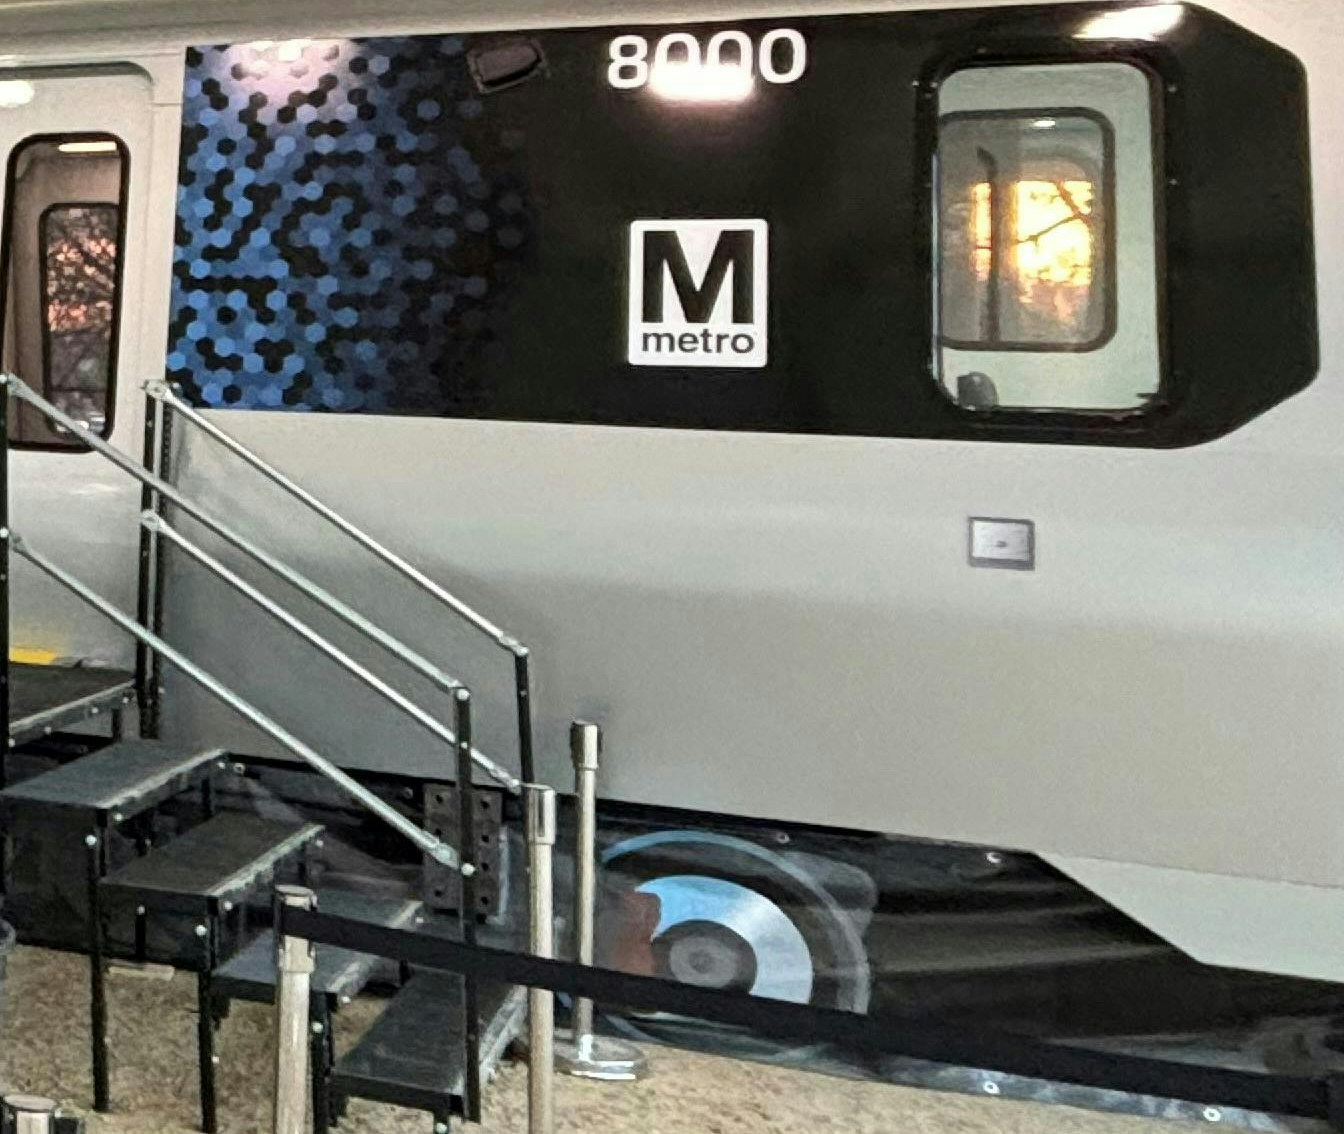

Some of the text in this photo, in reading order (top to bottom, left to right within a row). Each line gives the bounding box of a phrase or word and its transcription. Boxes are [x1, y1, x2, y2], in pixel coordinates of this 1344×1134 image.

[607, 28, 807, 90] 8000
[641, 229, 755, 325] M
[641, 329, 755, 354] metro
